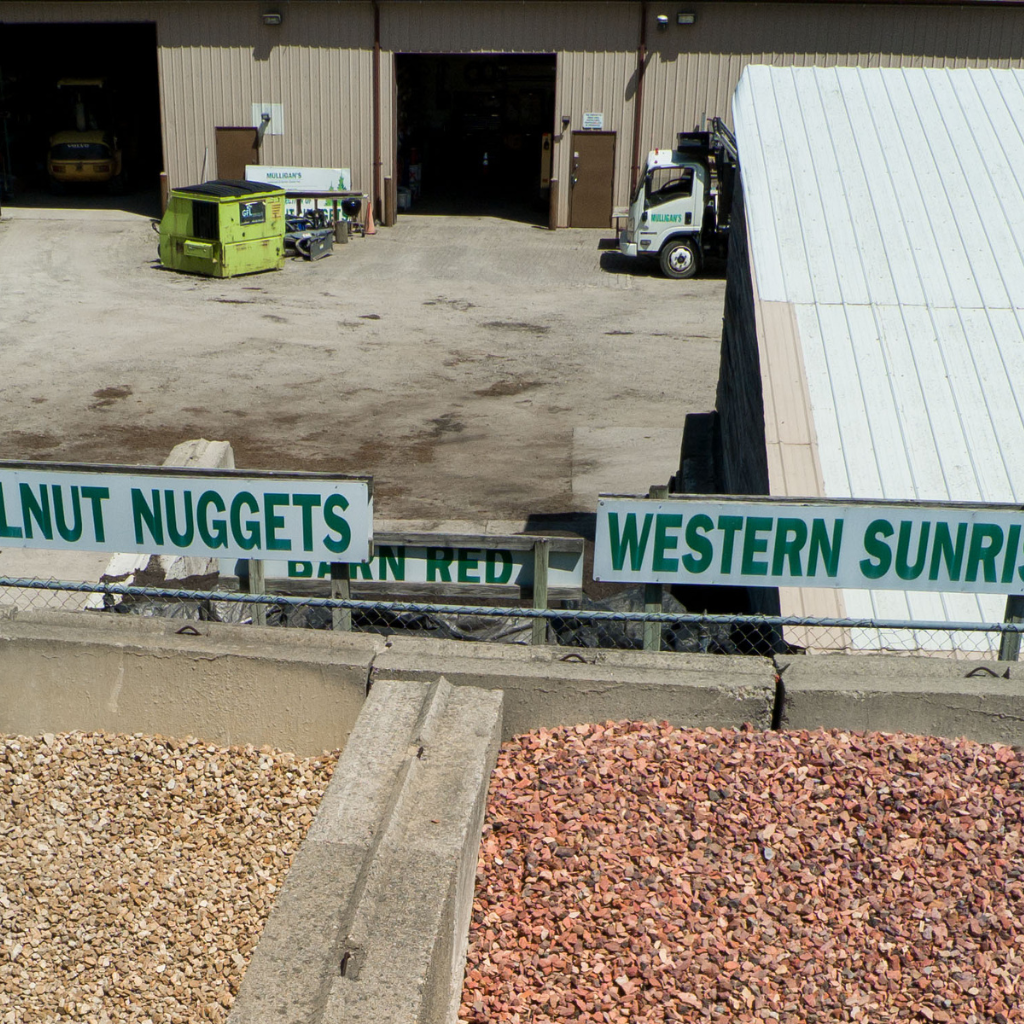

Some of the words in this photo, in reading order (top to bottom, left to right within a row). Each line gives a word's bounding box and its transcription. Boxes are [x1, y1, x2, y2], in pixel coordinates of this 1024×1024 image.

[651, 214, 682, 222] MULLIGAN'S
[130, 488, 352, 554] NUGGETS
[426, 547, 514, 584] RED
[607, 511, 844, 578] WESTERN
[859, 518, 1024, 584] SUNRI
